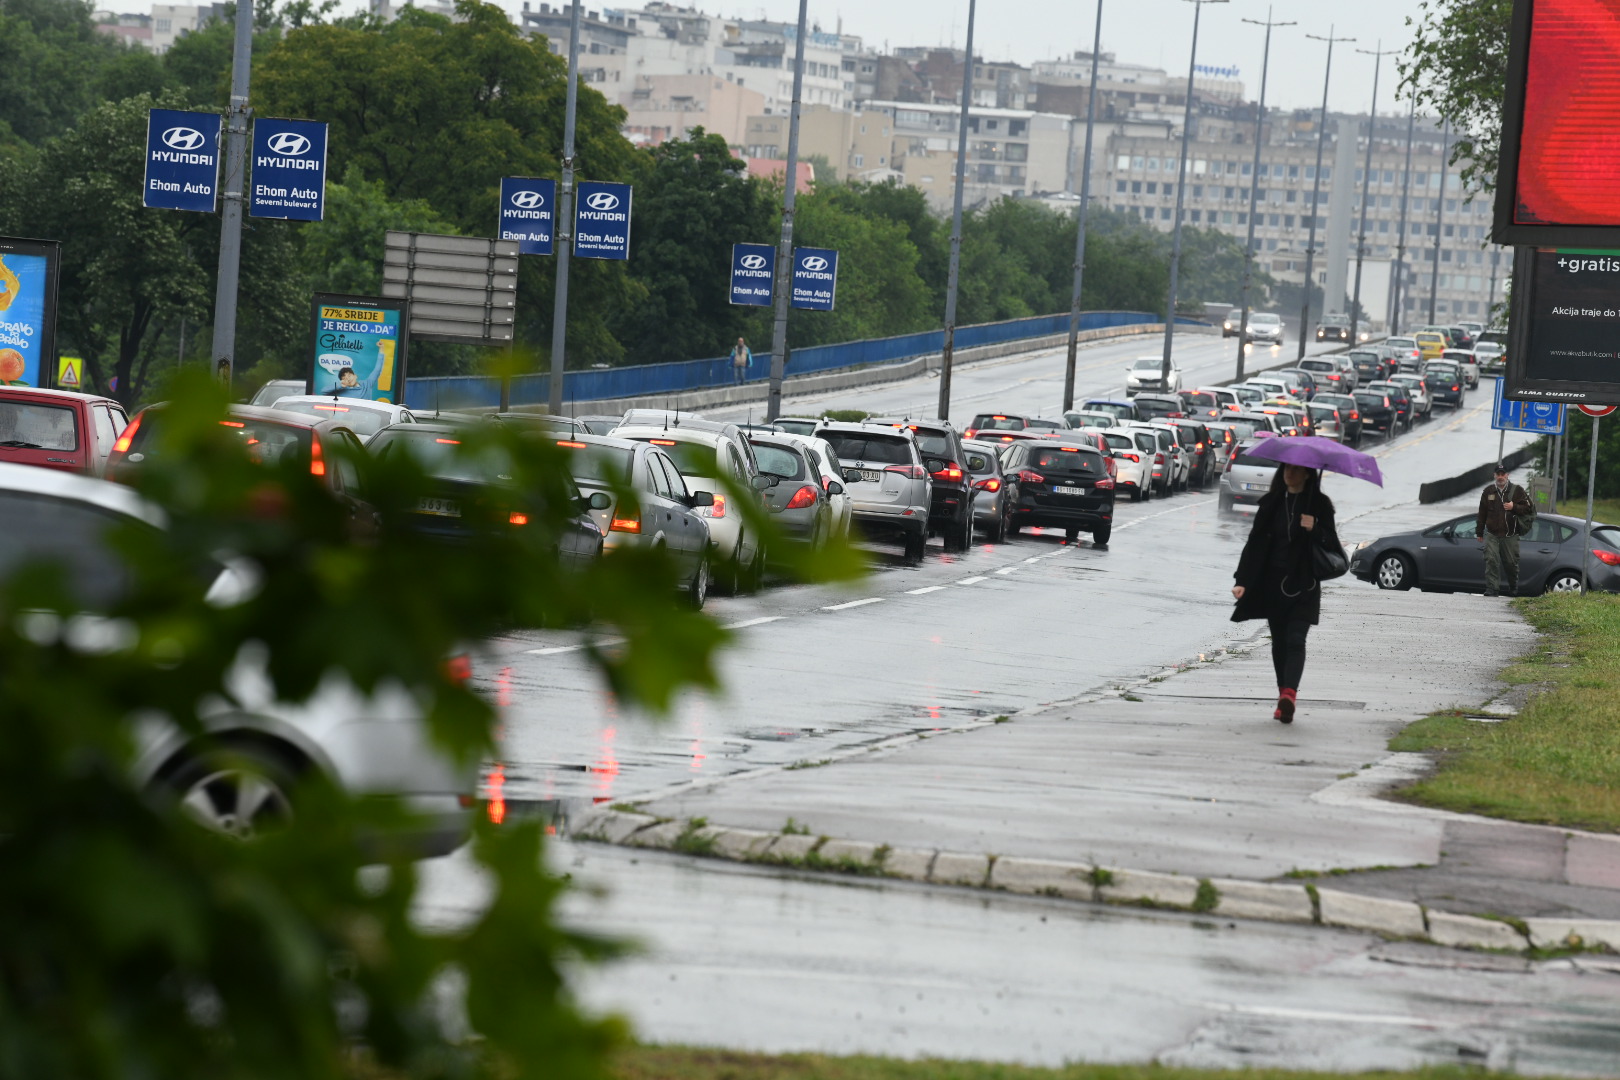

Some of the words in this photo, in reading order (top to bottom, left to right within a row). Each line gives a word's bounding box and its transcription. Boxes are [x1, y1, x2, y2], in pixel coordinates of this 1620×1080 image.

[152, 150, 213, 166] HYUNDAI
[257, 156, 319, 171] HYUNDAI
[150, 178, 181, 192] Ehom
[183, 182, 211, 195] Auto
[256, 184, 287, 198] Ehom
[290, 187, 318, 200] Auto
[255, 198, 283, 207] Severni
[283, 200, 311, 209] bulevar
[503, 209, 551, 220] HYUNDAI
[579, 211, 626, 222] HYUNDAI
[502, 230, 527, 241] Ehom
[528, 232, 550, 242] Auto
[578, 232, 602, 243] Ehom
[603, 234, 625, 244] Auto
[598, 243, 619, 251] bulevar
[1557, 257, 1620, 273] +gratis
[734, 269, 771, 279] HYUNDAI
[795, 271, 833, 281] HYUNDAI
[733, 286, 752, 295] Ehom
[753, 287, 770, 297] Auto
[793, 288, 813, 297] Ehom
[813, 289, 831, 298] Auto
[324, 308, 343, 318] 77%
[344, 310, 379, 321] SRBIJE
[1551, 306, 1579, 317] Akcija
[1581, 308, 1602, 318] traje
[1603, 309, 1616, 317] do
[323, 320, 334, 331] JE
[336, 321, 369, 333] REKLO
